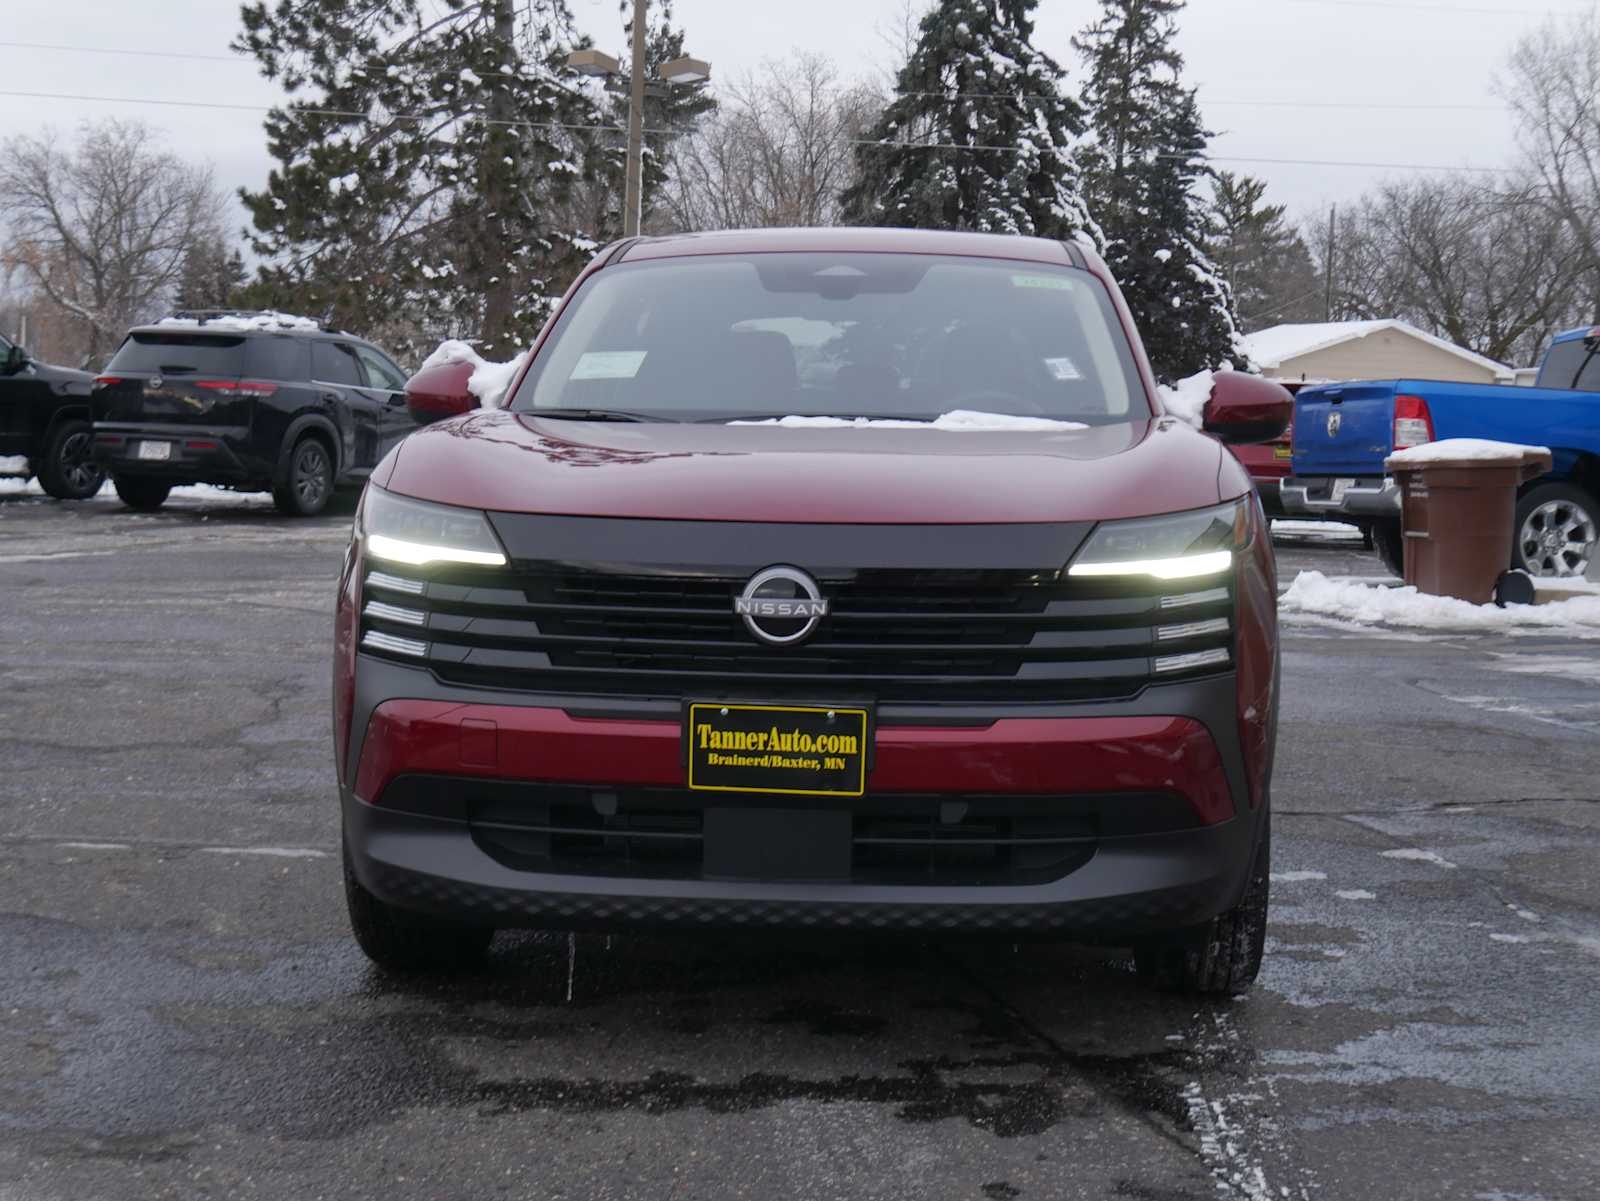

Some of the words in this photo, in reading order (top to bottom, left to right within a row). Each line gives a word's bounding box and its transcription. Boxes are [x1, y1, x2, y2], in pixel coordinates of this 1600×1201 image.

[736, 601, 826, 615] NISSAN
[697, 724, 858, 754] TannerAuto.com
[708, 754, 821, 771] Brainerd/Baxter,
[824, 757, 846, 770] MN
